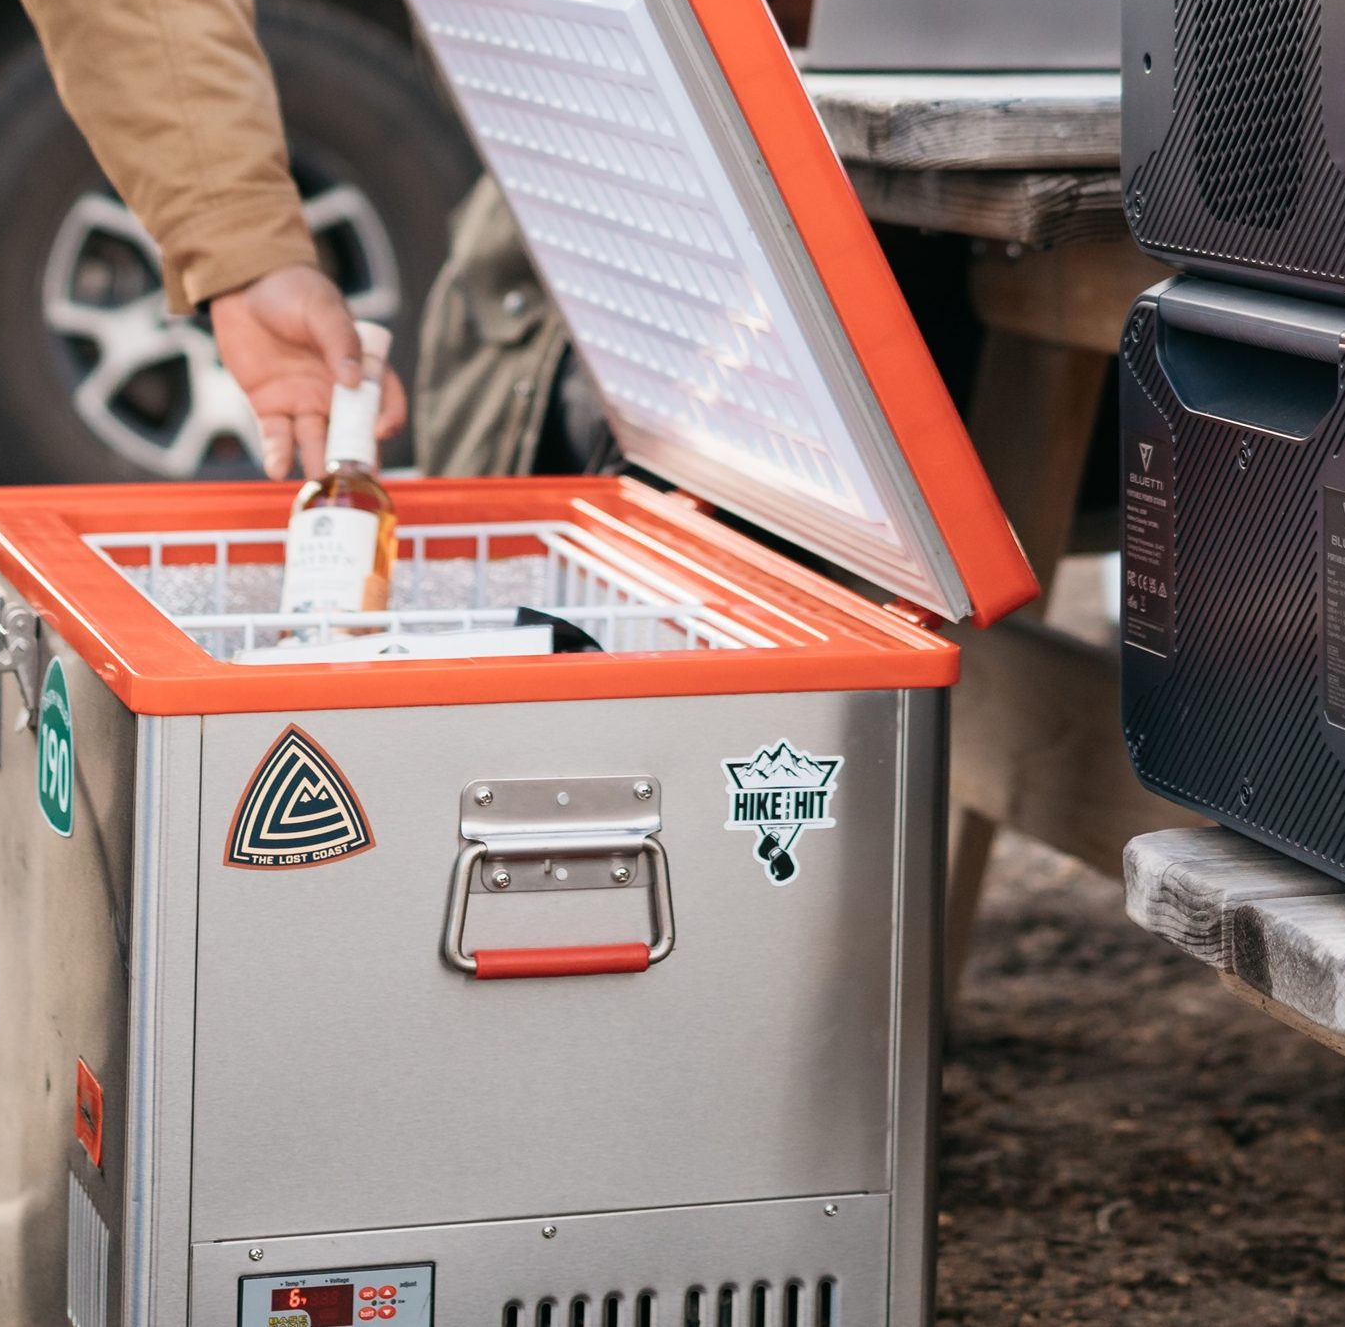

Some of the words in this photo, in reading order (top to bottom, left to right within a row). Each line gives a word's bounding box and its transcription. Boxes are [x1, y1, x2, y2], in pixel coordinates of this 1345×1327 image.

[1129, 472, 1164, 490] BLUETTI
[42, 723, 70, 813] 190
[734, 792, 782, 821] HIKE
[794, 790, 828, 819] HIT
[252, 855, 273, 865] THE
[279, 855, 308, 864] LOST
[312, 844, 349, 861] COAST
